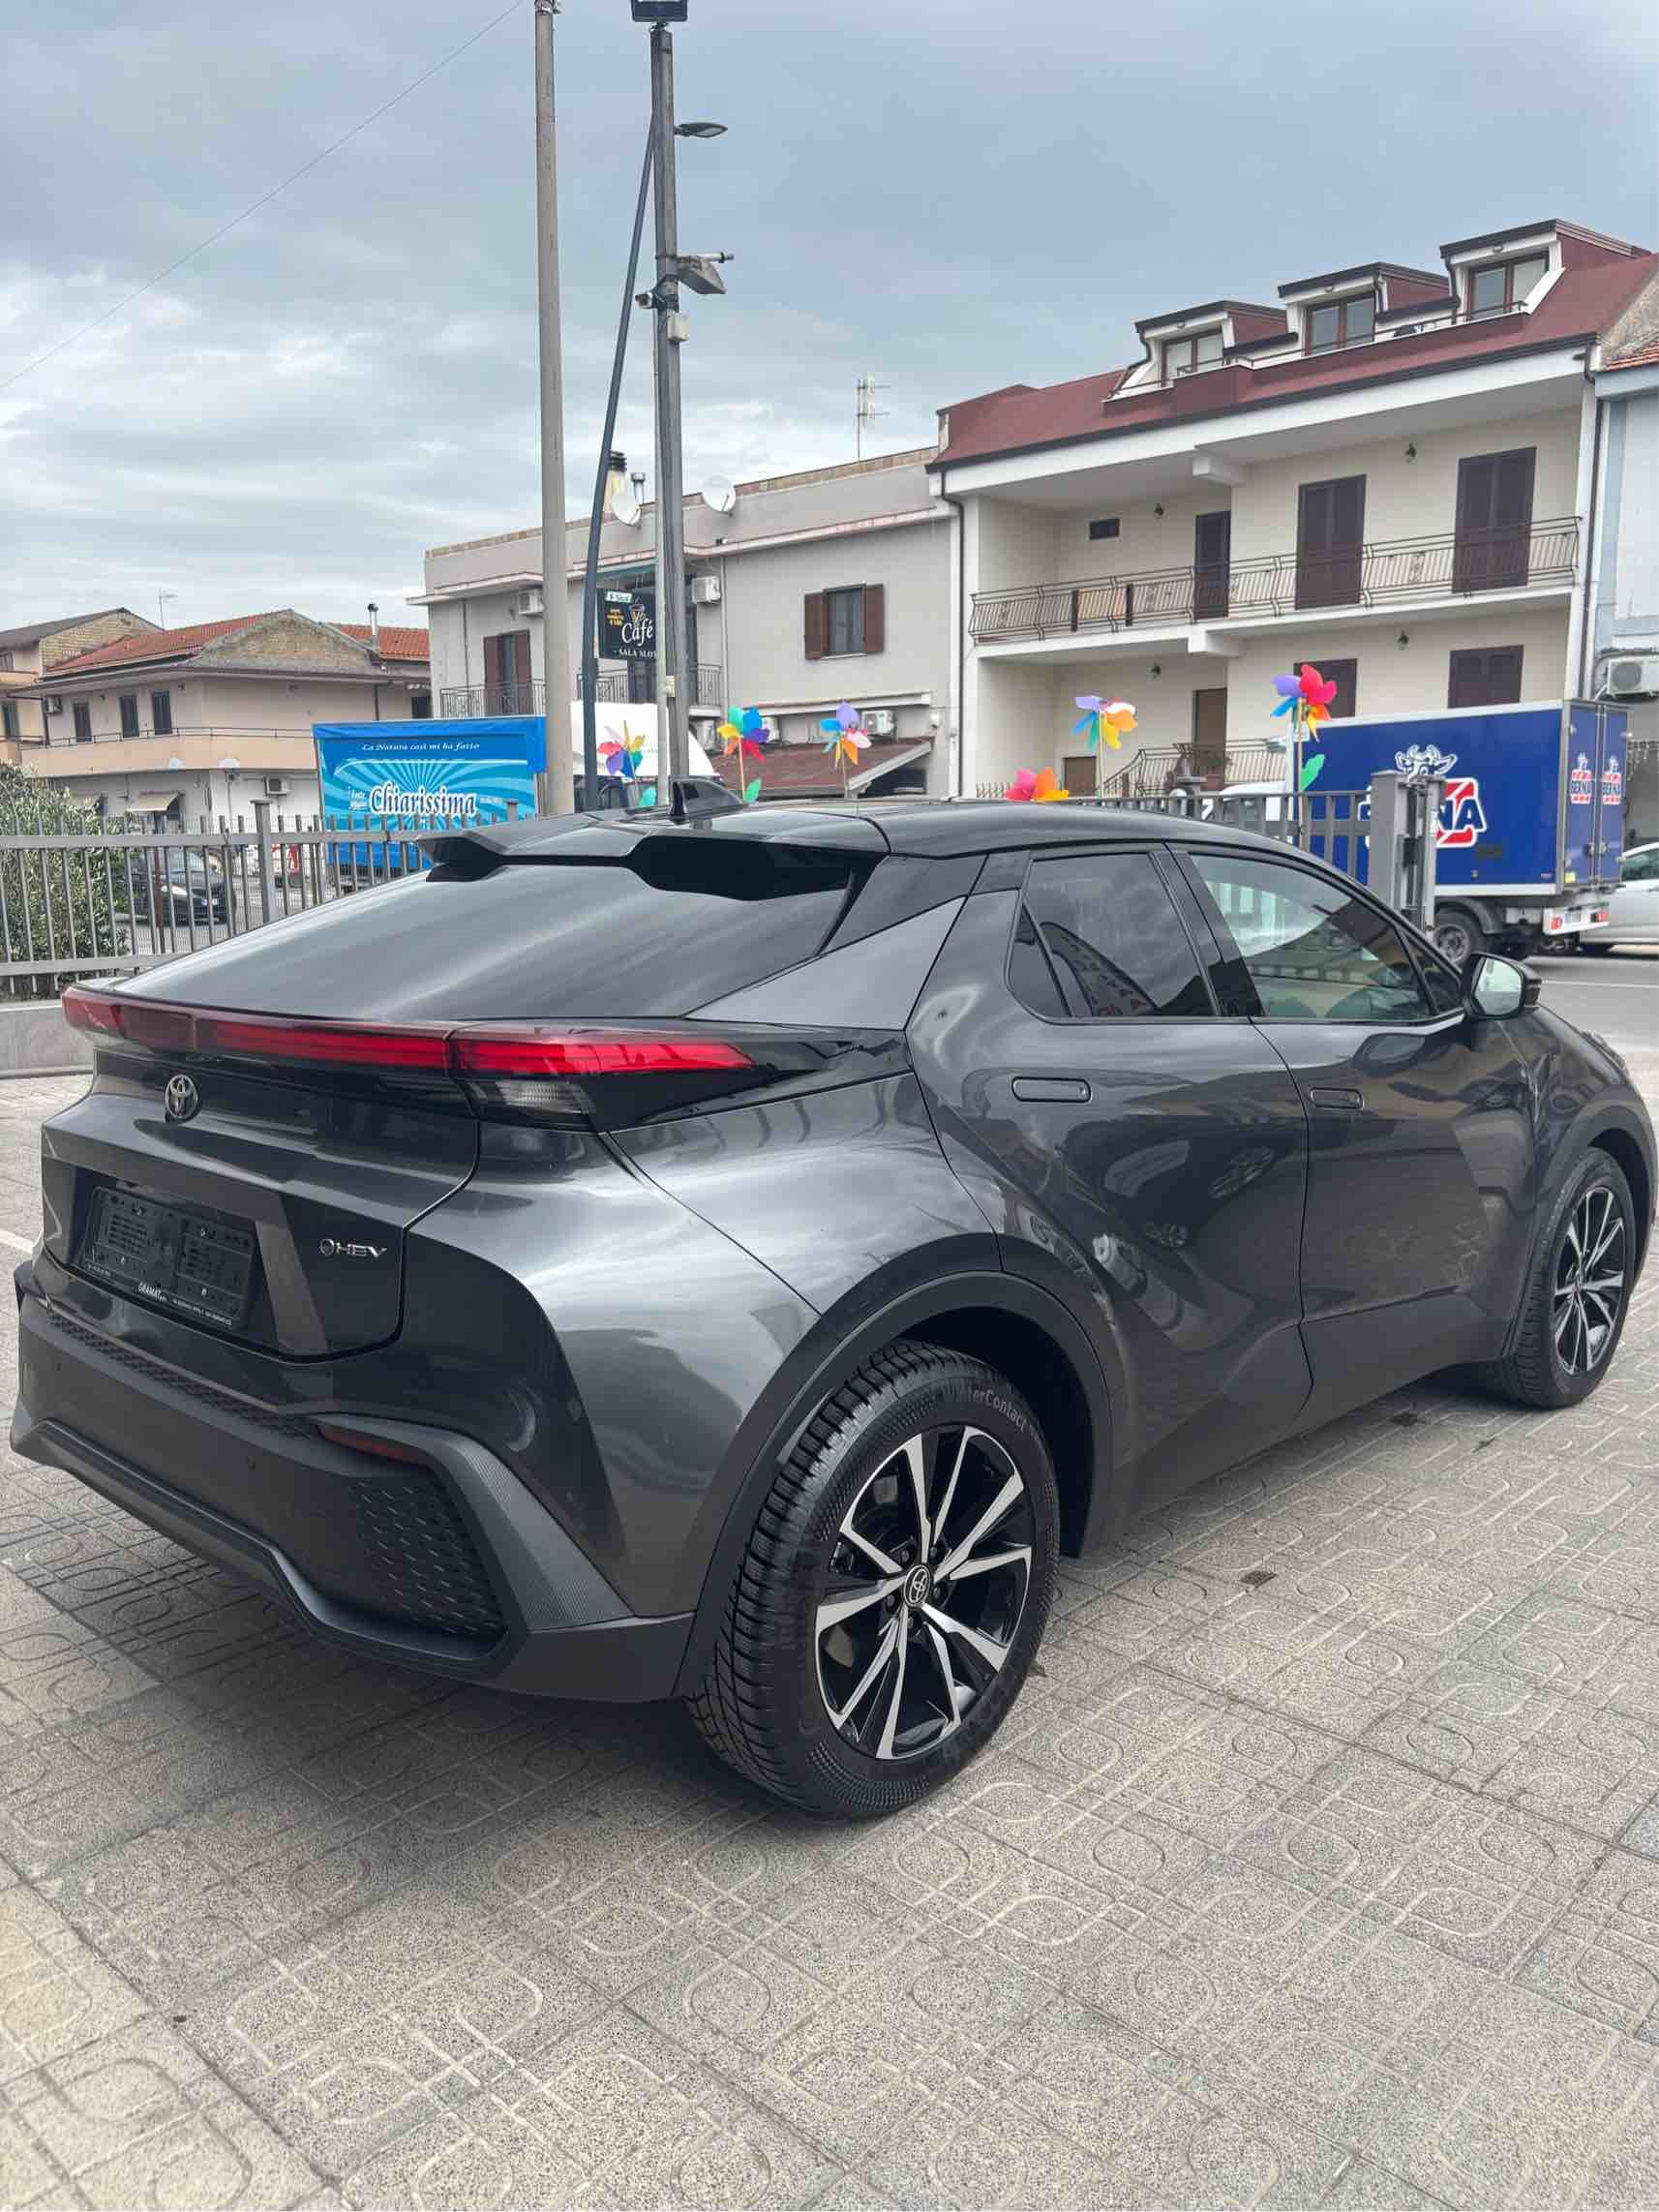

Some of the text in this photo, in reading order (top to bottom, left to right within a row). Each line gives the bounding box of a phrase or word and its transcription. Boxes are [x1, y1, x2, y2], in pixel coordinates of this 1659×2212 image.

[621, 619, 654, 647] Café
[369, 780, 479, 817] Chiarissima
[336, 1241, 388, 1258] HEV
